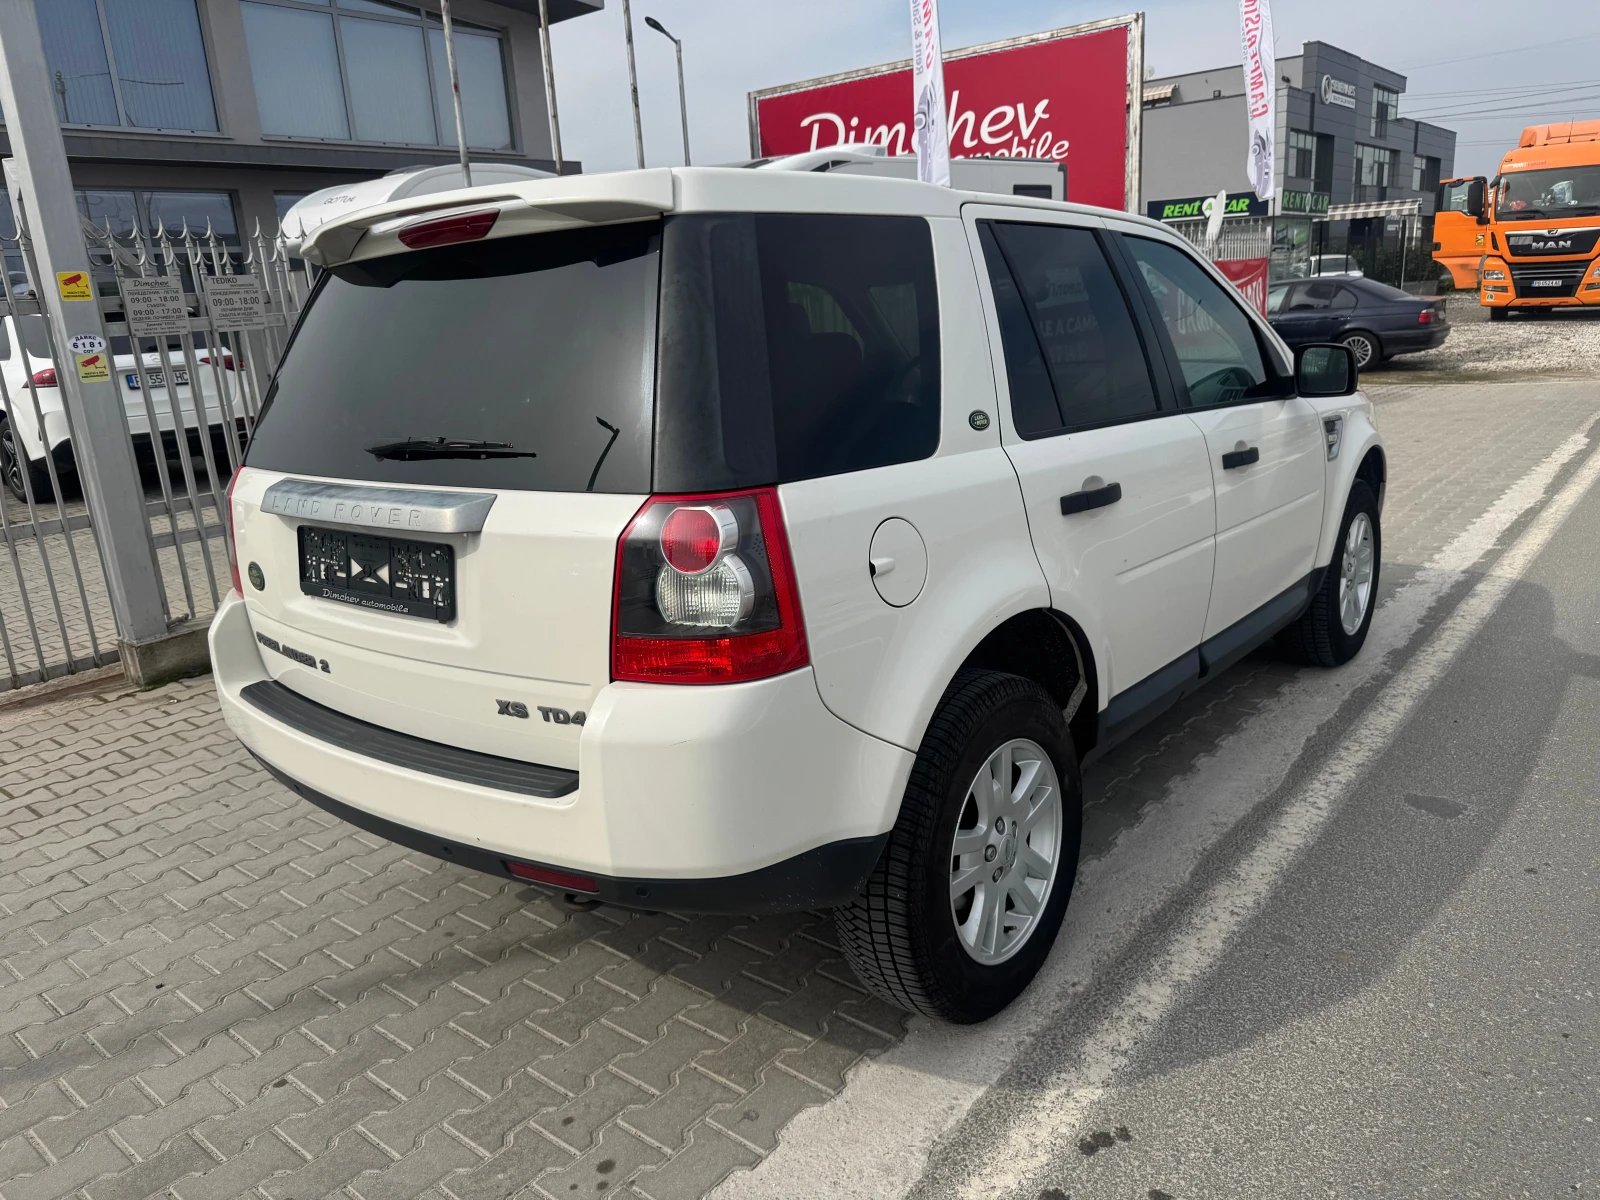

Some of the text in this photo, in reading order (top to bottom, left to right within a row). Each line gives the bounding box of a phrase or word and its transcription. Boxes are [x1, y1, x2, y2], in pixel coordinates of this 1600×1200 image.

[800, 90, 1049, 156] Dimhev
[1282, 191, 1306, 209] RENT
[1311, 194, 1329, 211] CAR
[1531, 240, 1572, 250] MAN
[210, 277, 238, 285] TEDIKO
[130, 296, 152, 304] 09:00
[158, 295, 180, 303] 18:00
[161, 307, 182, 315] 17:00
[271, 495, 423, 528] LAND ROVER
[322, 588, 409, 614] Dimchev automobile
[319, 658, 331, 674] 2
[495, 698, 587, 727] XS TD4
